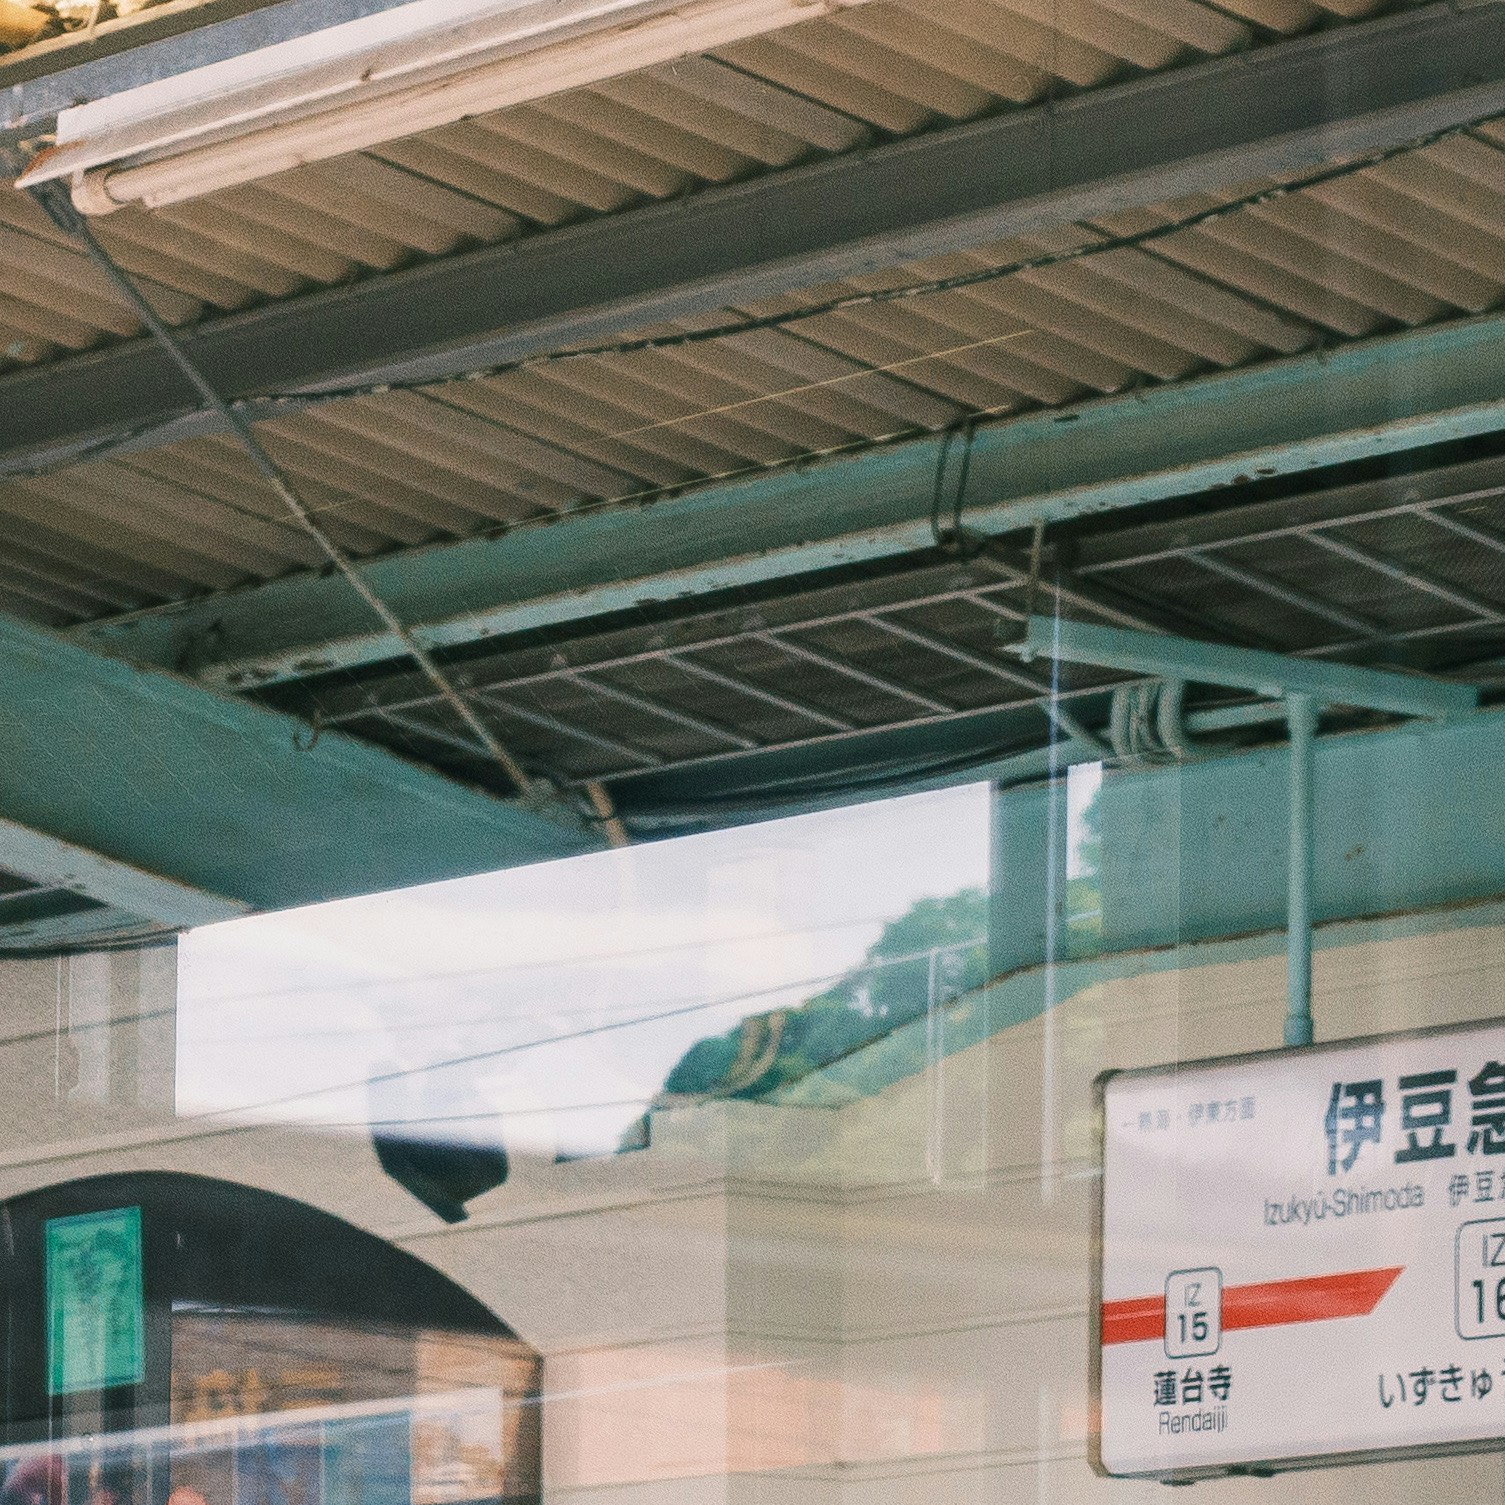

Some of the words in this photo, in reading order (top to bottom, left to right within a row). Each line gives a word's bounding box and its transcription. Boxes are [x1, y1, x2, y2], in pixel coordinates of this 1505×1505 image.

[1174, 1310, 1210, 1345] 15
[1151, 1363, 1234, 1407] 蓮台寺
[1157, 1404, 1229, 1438] Rendaiji
